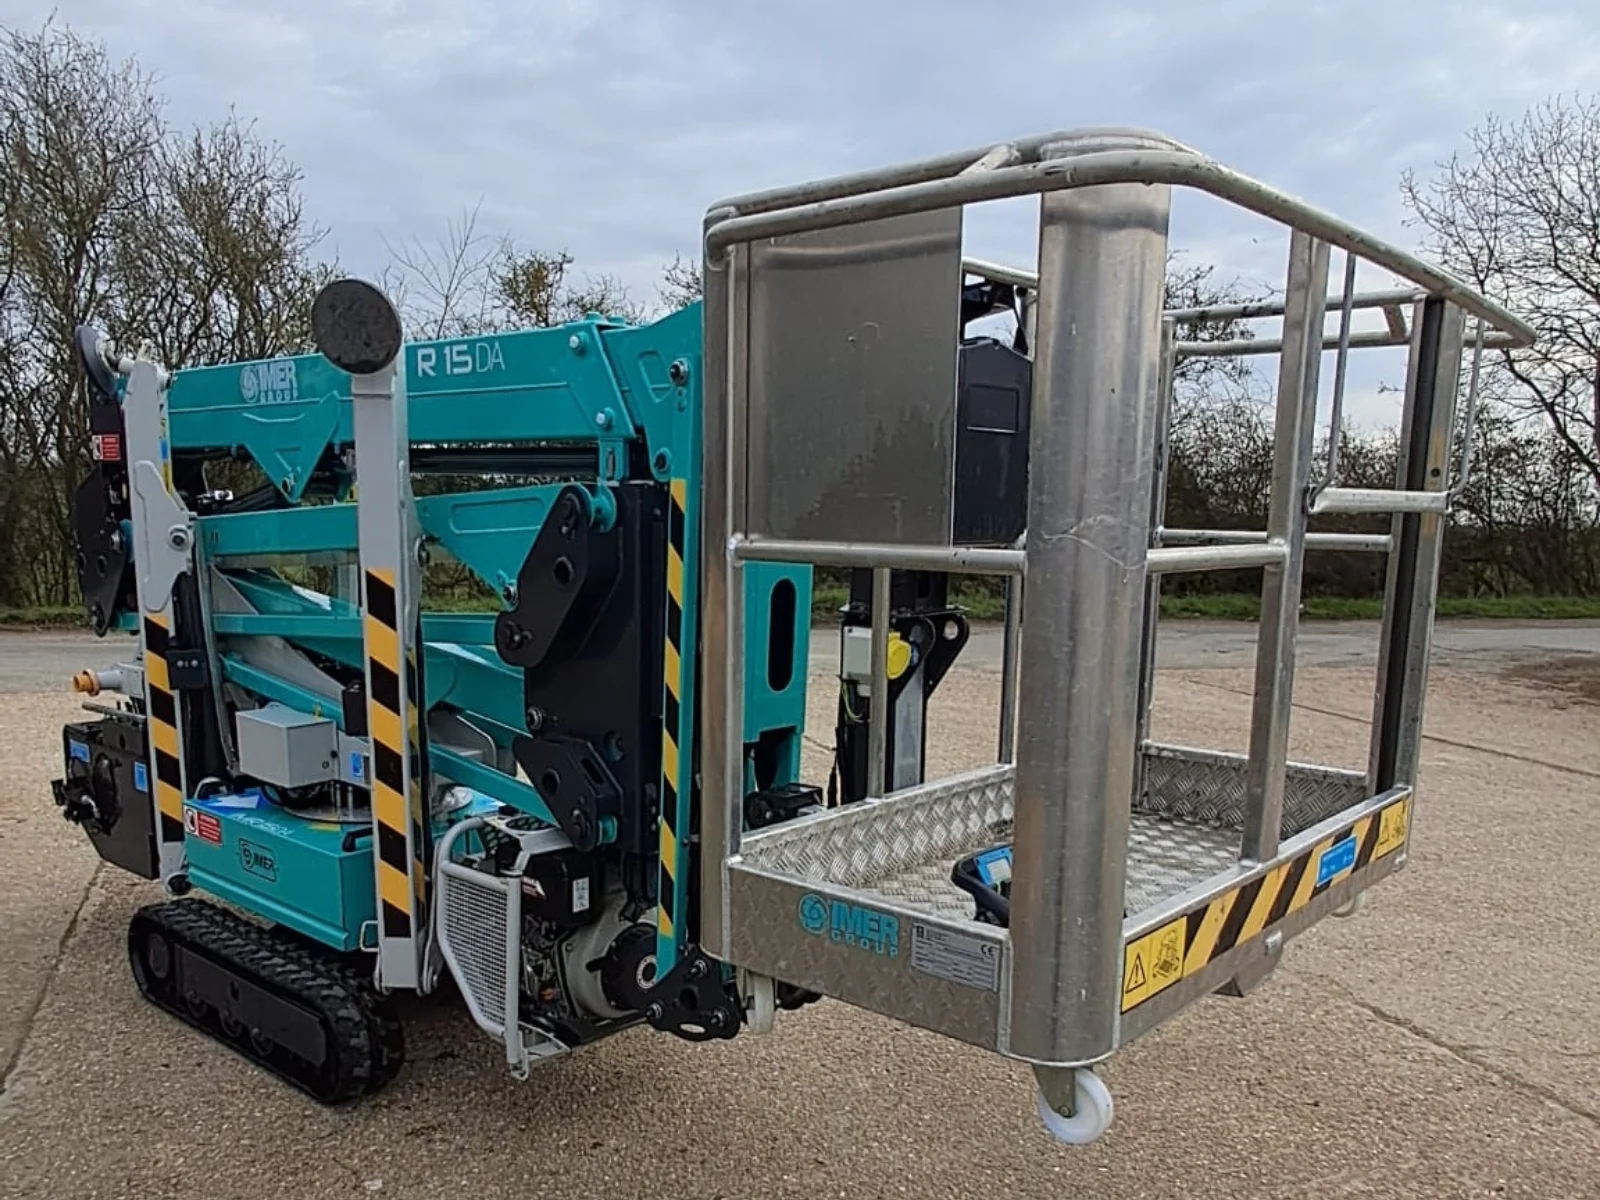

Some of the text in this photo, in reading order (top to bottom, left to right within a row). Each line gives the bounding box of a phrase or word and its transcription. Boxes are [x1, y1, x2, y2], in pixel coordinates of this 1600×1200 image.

[257, 360, 297, 391] IMER
[417, 347, 437, 378] R
[831, 900, 899, 943] IMER
[831, 929, 898, 959] GROUP
